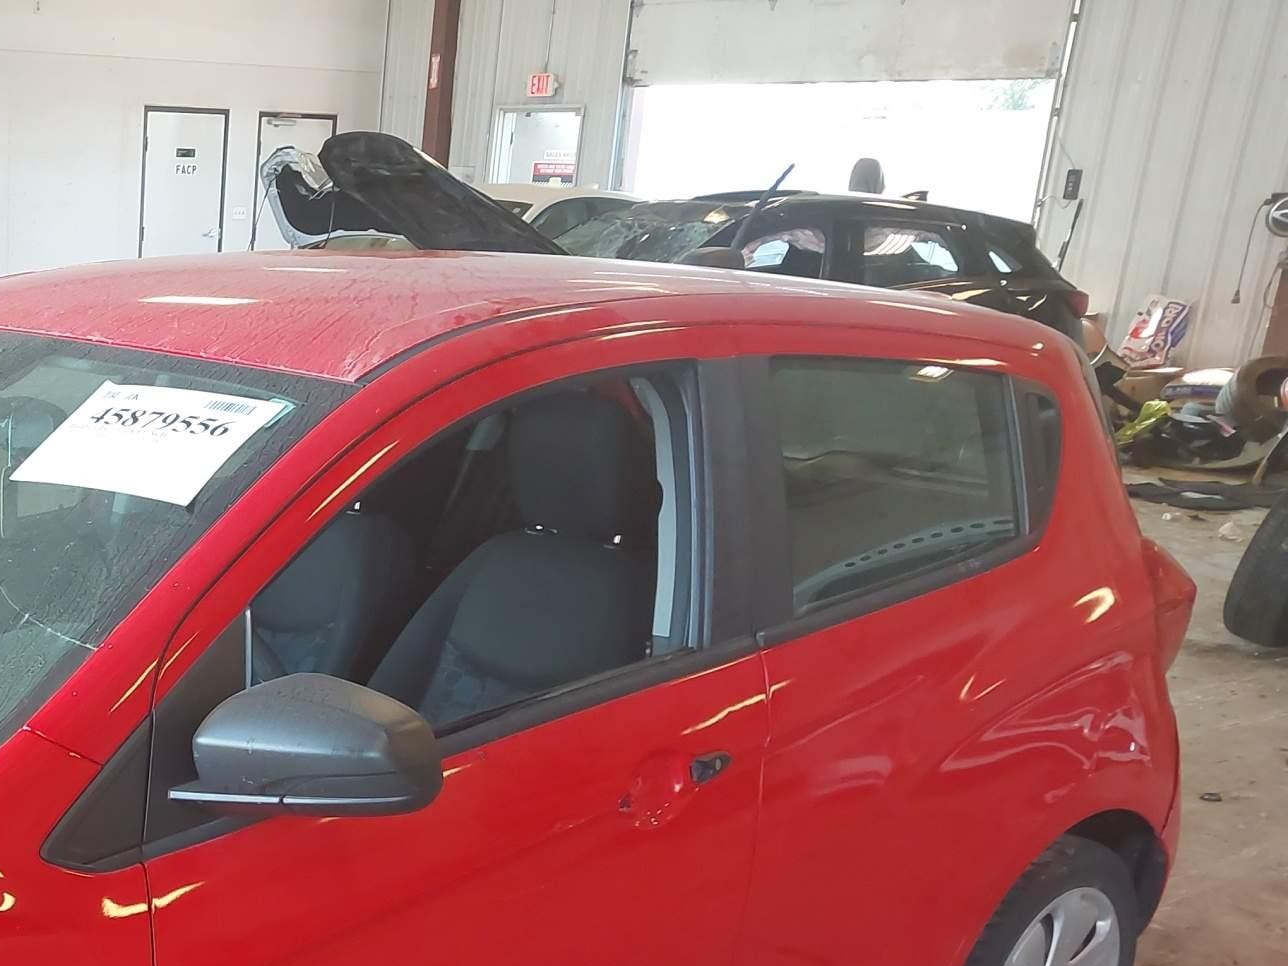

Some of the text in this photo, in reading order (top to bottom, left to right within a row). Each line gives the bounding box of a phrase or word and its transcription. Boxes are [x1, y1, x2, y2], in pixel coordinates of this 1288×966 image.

[531, 75, 550, 95] EXIT
[176, 164, 197, 175] FACP
[90, 407, 236, 437] 45879556
